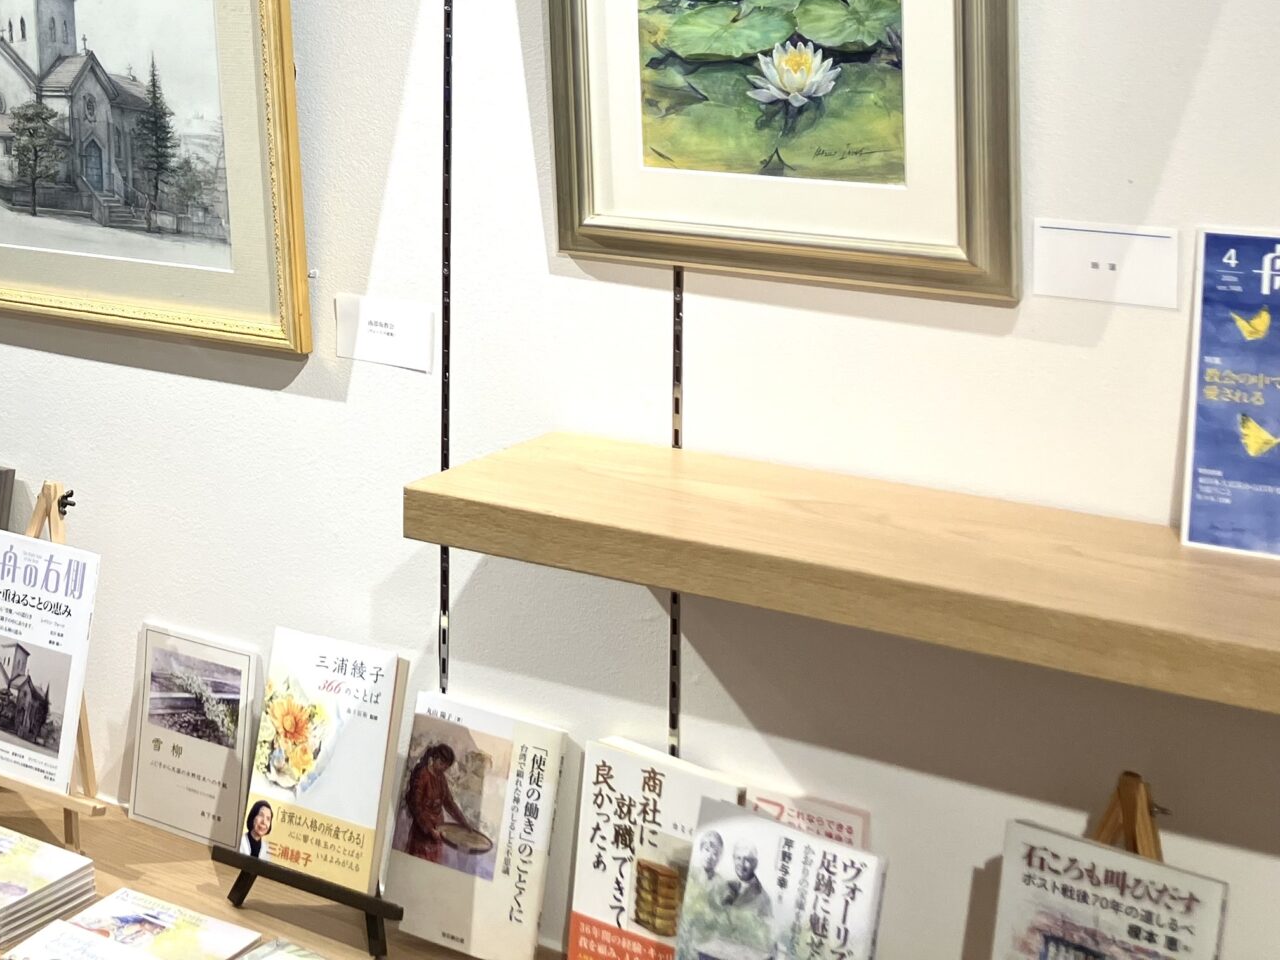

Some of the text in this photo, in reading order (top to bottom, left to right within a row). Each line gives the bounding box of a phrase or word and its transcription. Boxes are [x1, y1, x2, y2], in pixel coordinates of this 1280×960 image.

[1222, 248, 1239, 267] 4
[315, 655, 385, 684] 三浦綾子
[276, 806, 365, 848] 「言葉は人格の所産である」
[637, 767, 665, 848] 商社に
[786, 806, 854, 836] これならできる
[266, 841, 313, 868] 三浦綾子
[509, 745, 549, 924] 「使徒の働き」のごとくに
[316, 852, 360, 872] いまよみがえる
[609, 793, 637, 929] 就職できて
[1021, 841, 1201, 916] 石ころも叫びだす
[1022, 872, 1196, 936] ポスト戦後70年の道しるべ
